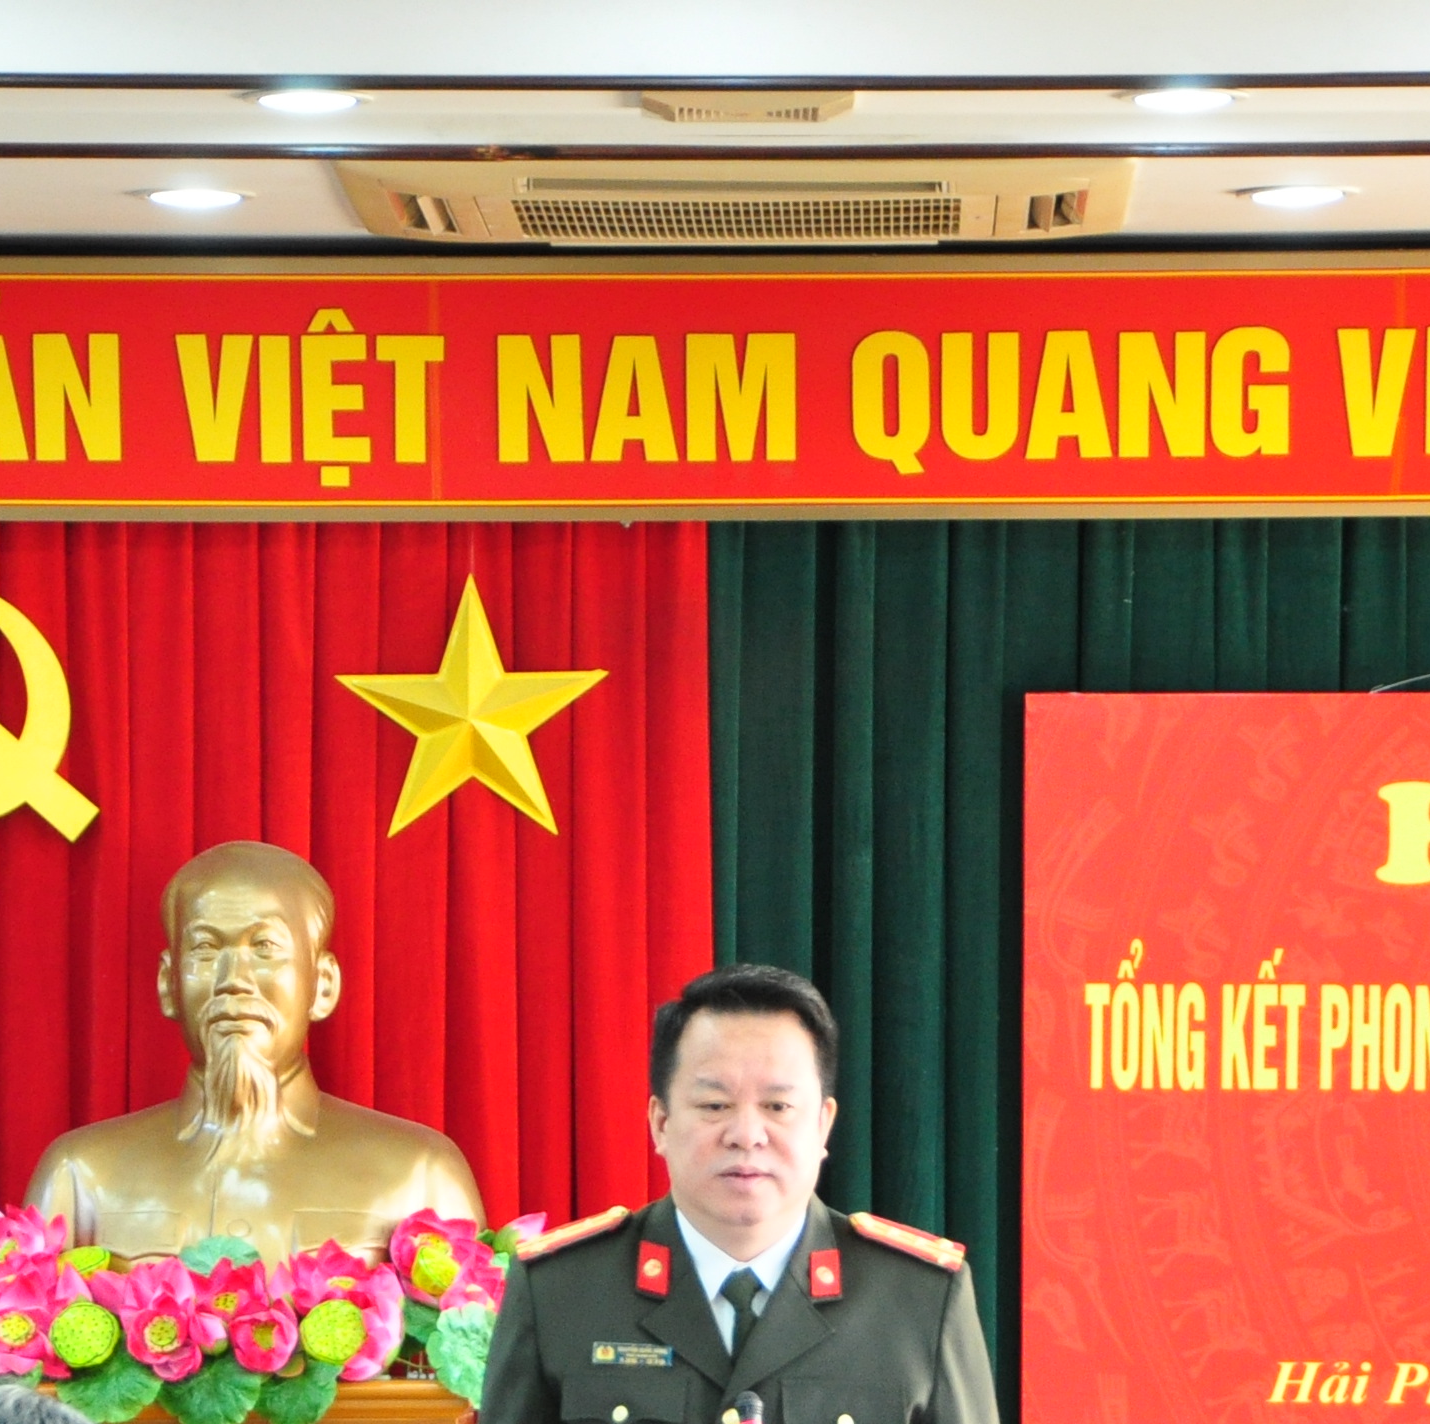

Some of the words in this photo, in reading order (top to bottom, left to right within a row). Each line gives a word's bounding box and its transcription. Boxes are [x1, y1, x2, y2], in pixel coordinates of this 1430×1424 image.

[175, 308, 446, 488] VIỆT
[496, 332, 797, 466] NAM
[852, 326, 1291, 476] QUANG
[1084, 938, 1206, 1091] TỔNG
[1221, 948, 1306, 1091] KẾT
[1266, 1360, 1372, 1408] Hải
